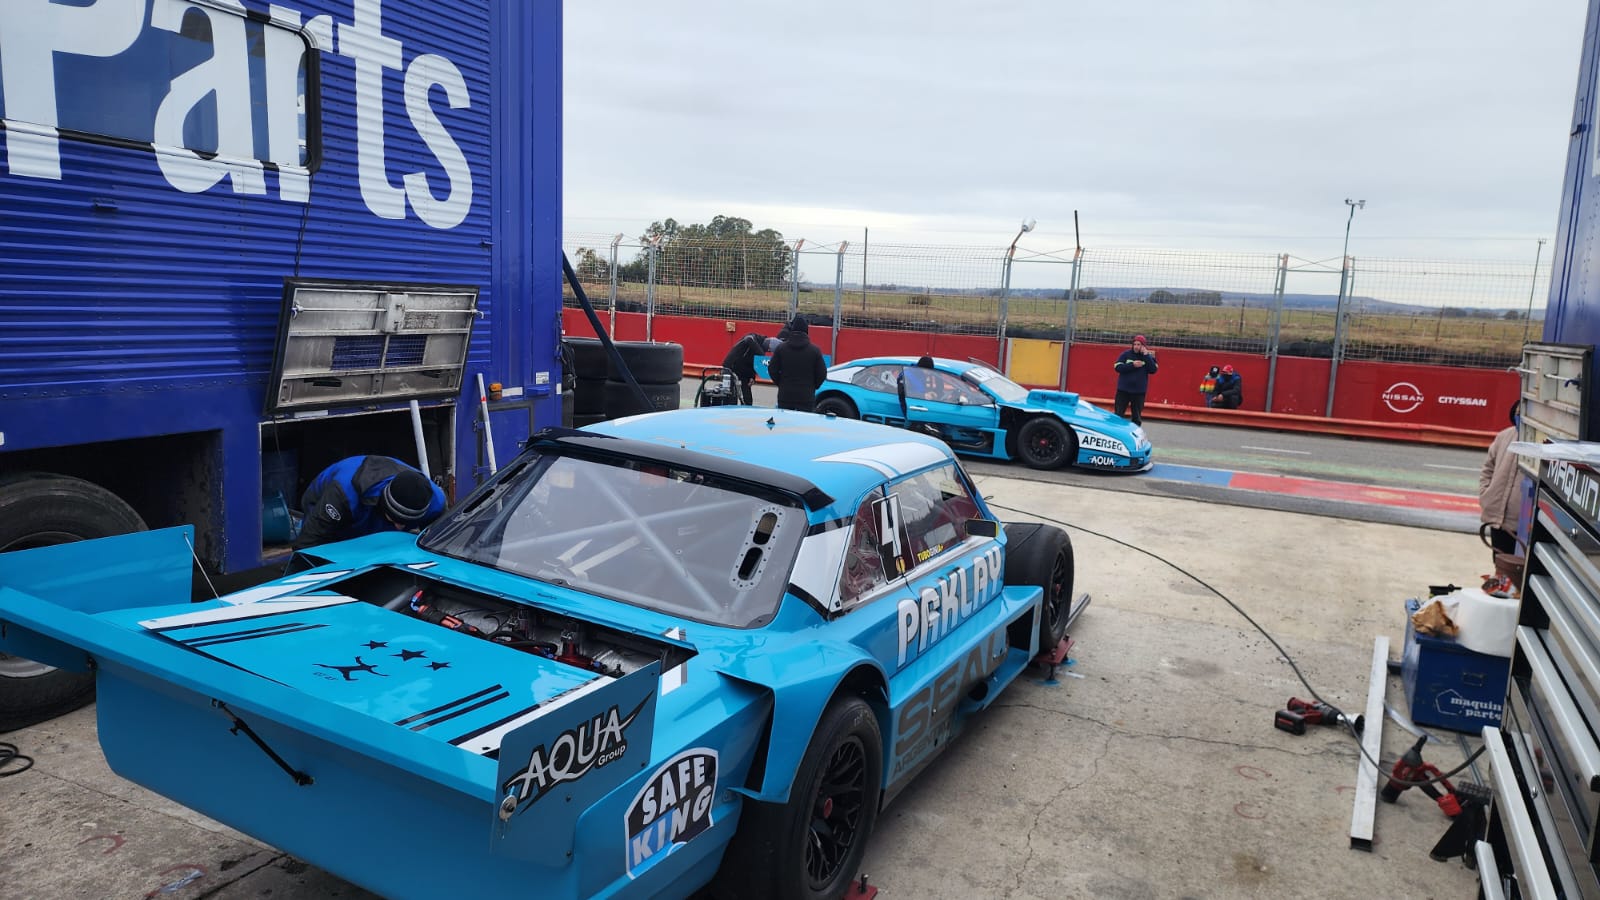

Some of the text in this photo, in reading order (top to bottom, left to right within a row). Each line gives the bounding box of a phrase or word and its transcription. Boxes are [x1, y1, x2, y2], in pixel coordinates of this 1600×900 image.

[0, 0, 473, 229] Parts
[1382, 393, 1424, 402] NISSAN
[1438, 396, 1487, 406] CITYSSAN
[1082, 435, 1123, 451] APERSEG
[1091, 456, 1114, 467] AQUA
[512, 706, 624, 800] AQUA
[598, 744, 626, 766] Group
[643, 756, 705, 825] SAFE
[632, 785, 712, 866] KING
